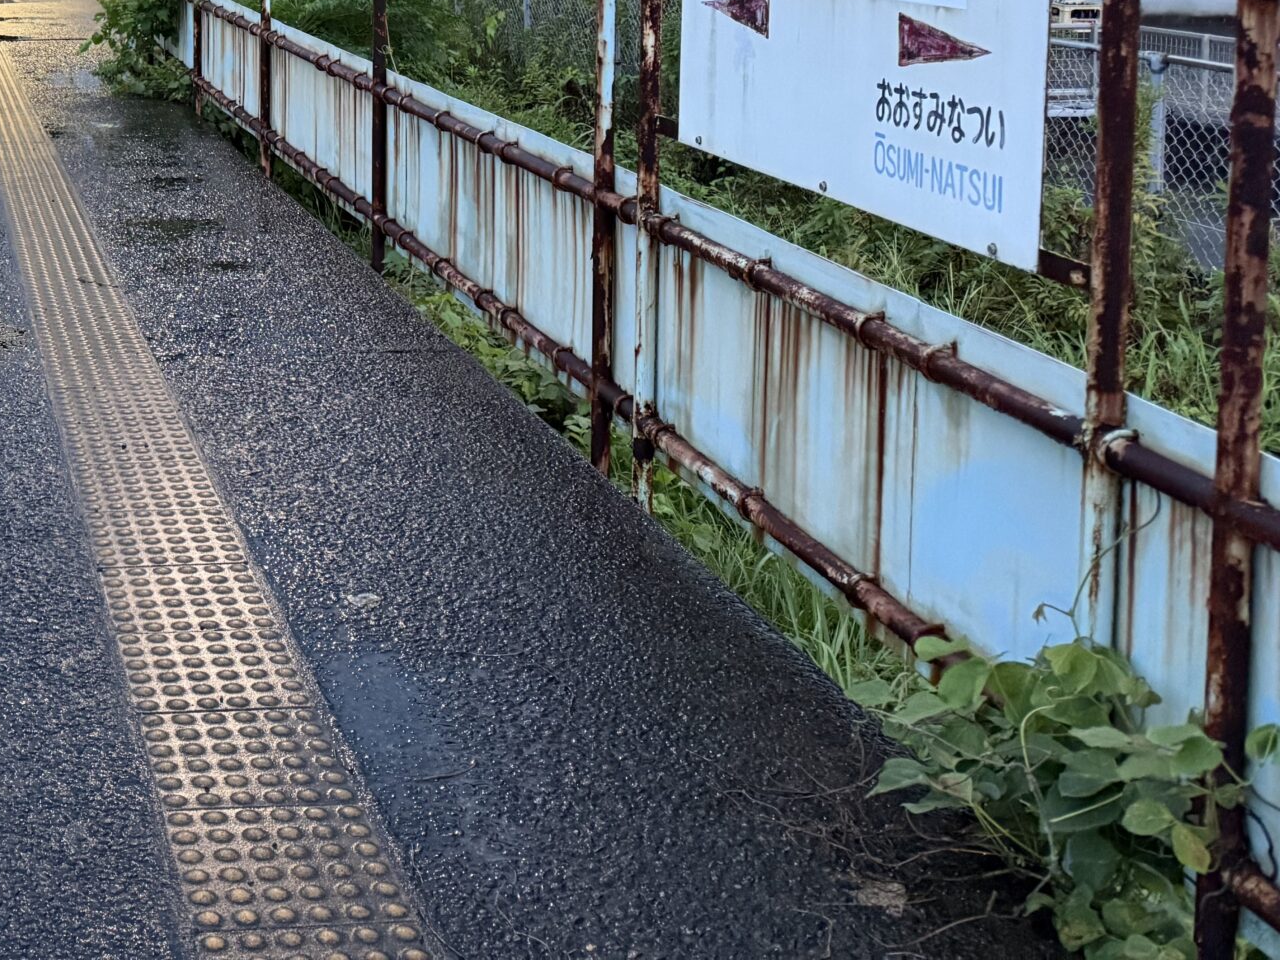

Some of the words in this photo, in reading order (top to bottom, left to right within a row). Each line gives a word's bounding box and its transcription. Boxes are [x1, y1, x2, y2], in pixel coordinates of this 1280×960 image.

[875, 77, 1006, 150] おおすみなつい
[873, 131, 1003, 213] ŌSUMI-NATSUI
